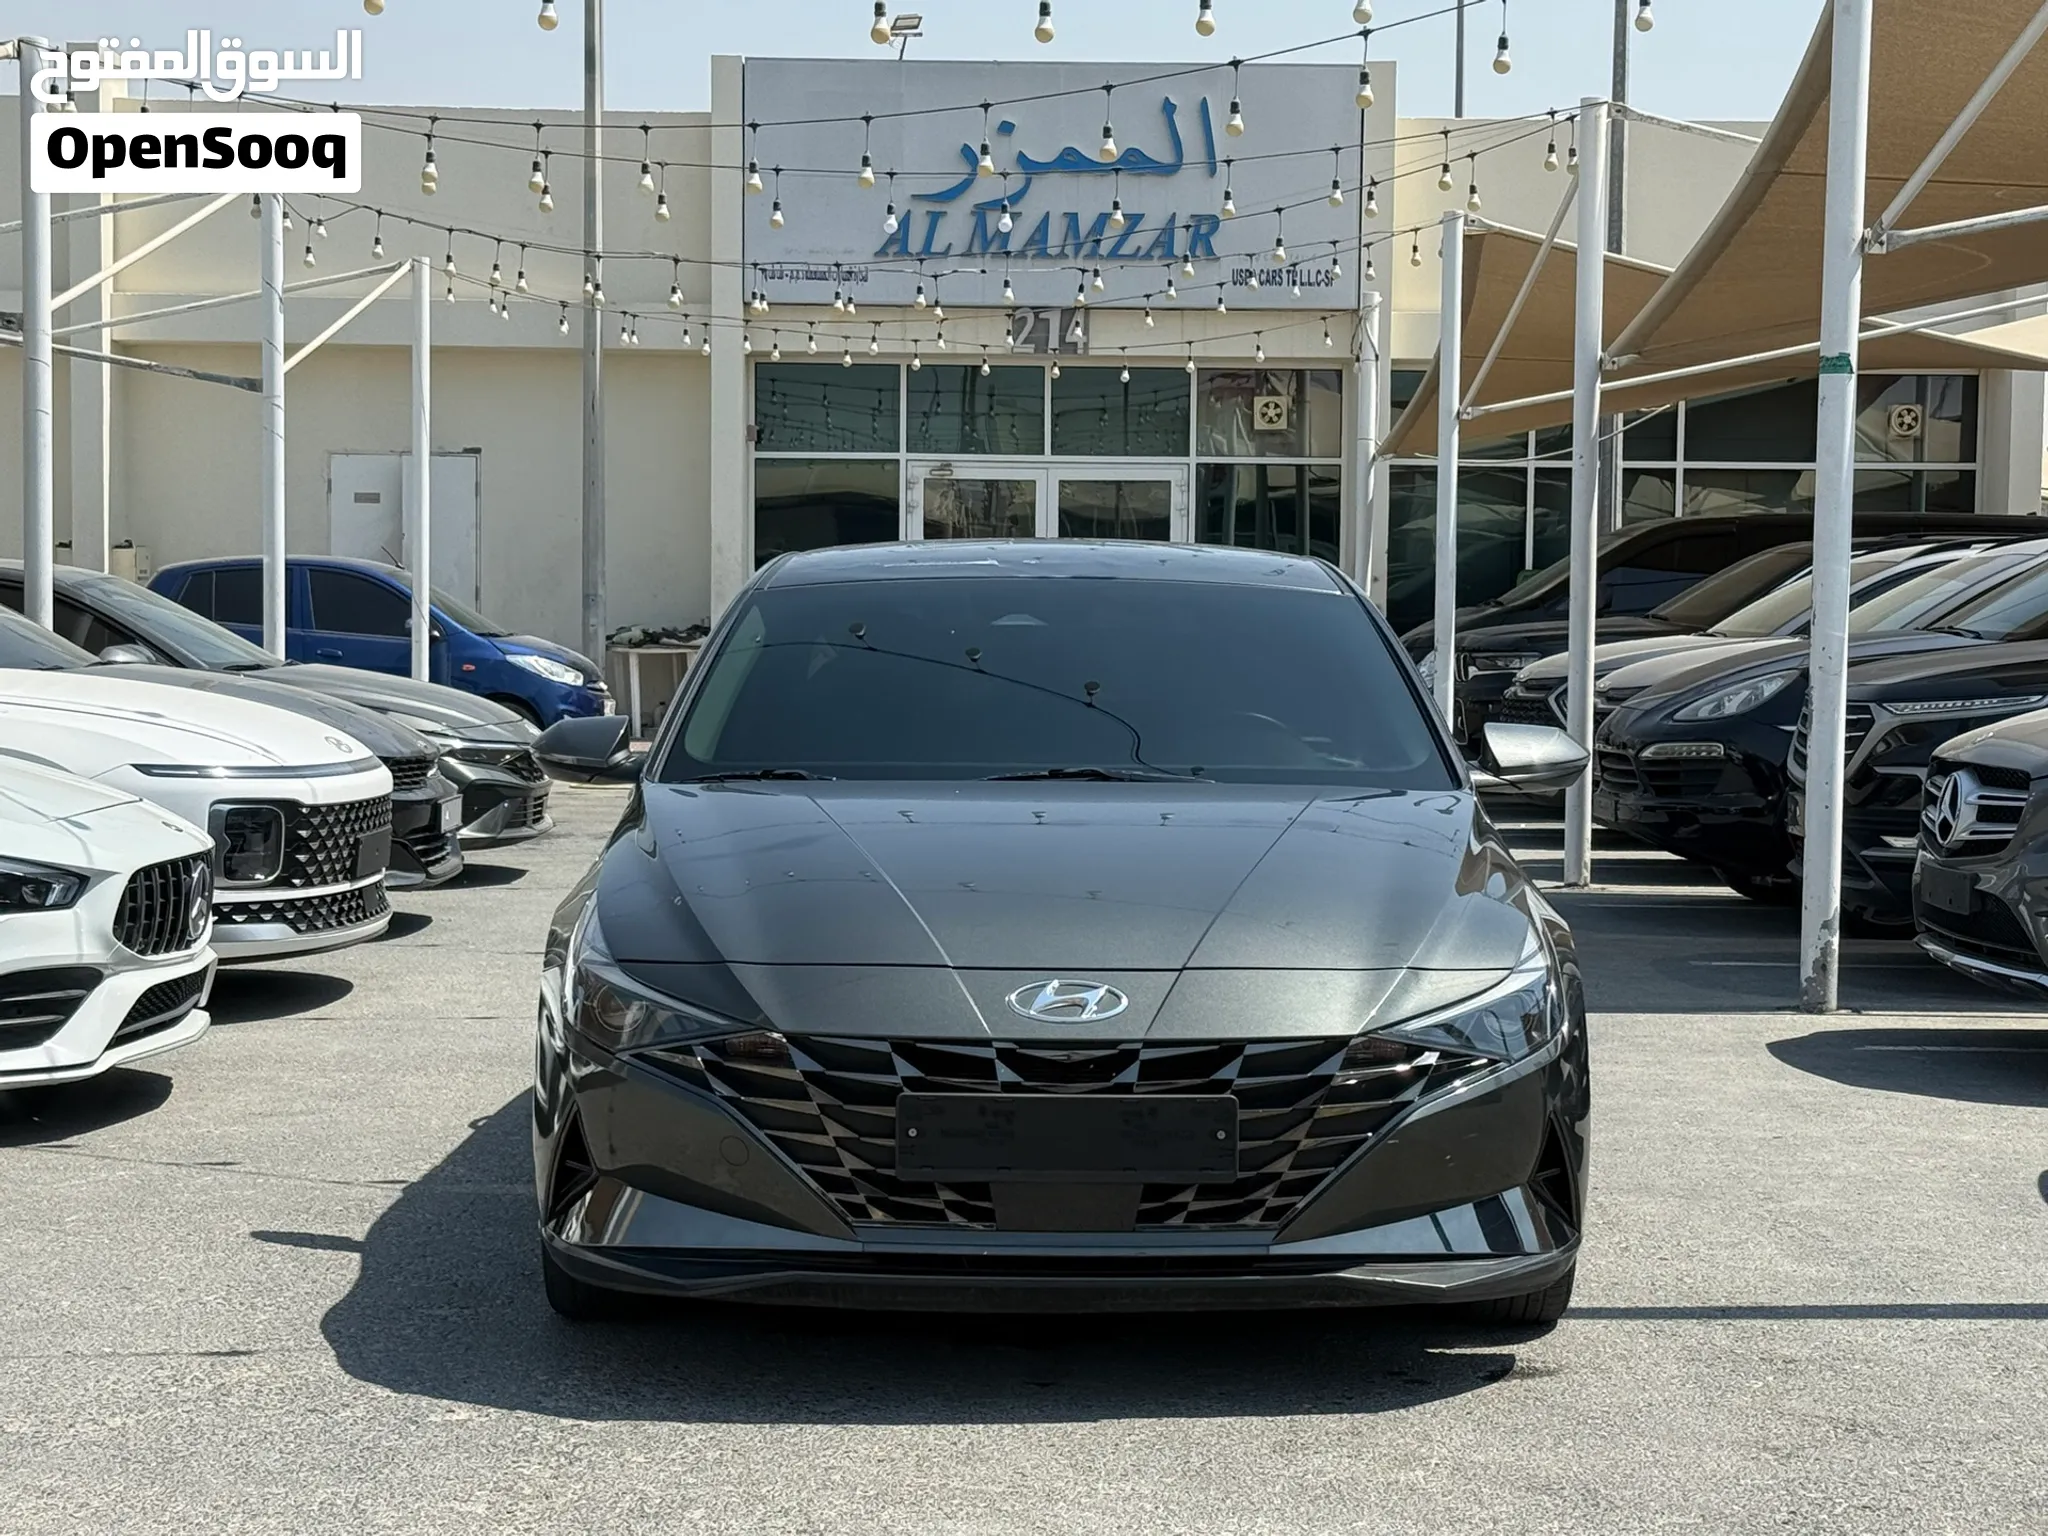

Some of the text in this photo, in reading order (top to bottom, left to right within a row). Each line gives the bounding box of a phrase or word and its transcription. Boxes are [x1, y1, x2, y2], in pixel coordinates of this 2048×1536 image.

[911, 96, 1217, 211] الممزر
[874, 210, 1221, 261] AL MAMZAR
[1259, 269, 1283, 286] CARS
[1012, 308, 1088, 354] 214
